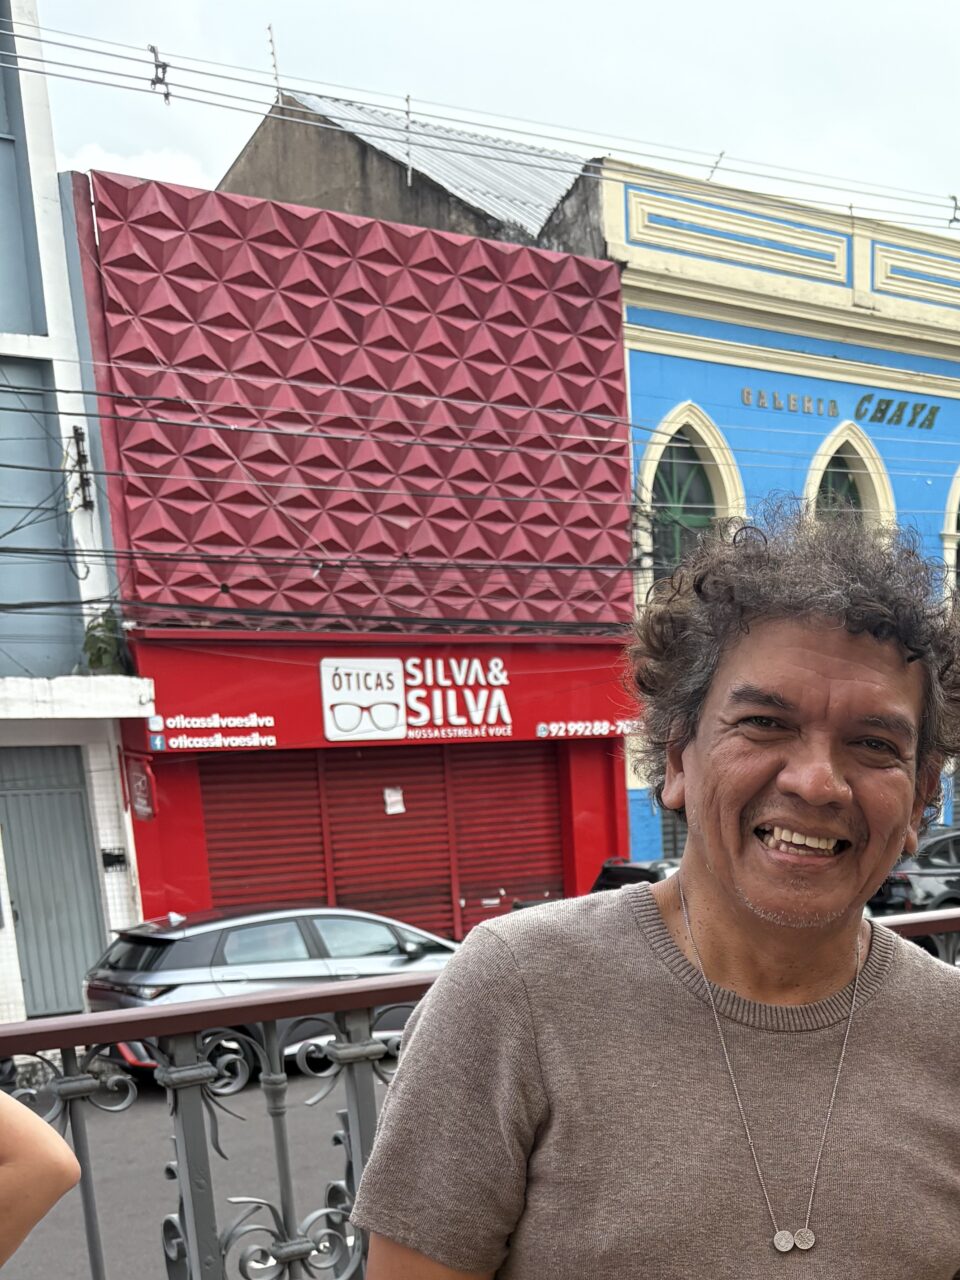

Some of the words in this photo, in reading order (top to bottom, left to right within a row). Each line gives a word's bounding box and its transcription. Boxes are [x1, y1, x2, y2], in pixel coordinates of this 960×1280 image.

[741, 387, 840, 417] GALERIA
[854, 393, 941, 430] CHAYA
[332, 667, 395, 691] ÓTICAS
[406, 688, 512, 726] SILVA
[407, 728, 440, 740] NOSSA
[441, 726, 480, 739] ESTRELA
[488, 724, 513, 737] VOCÊ
